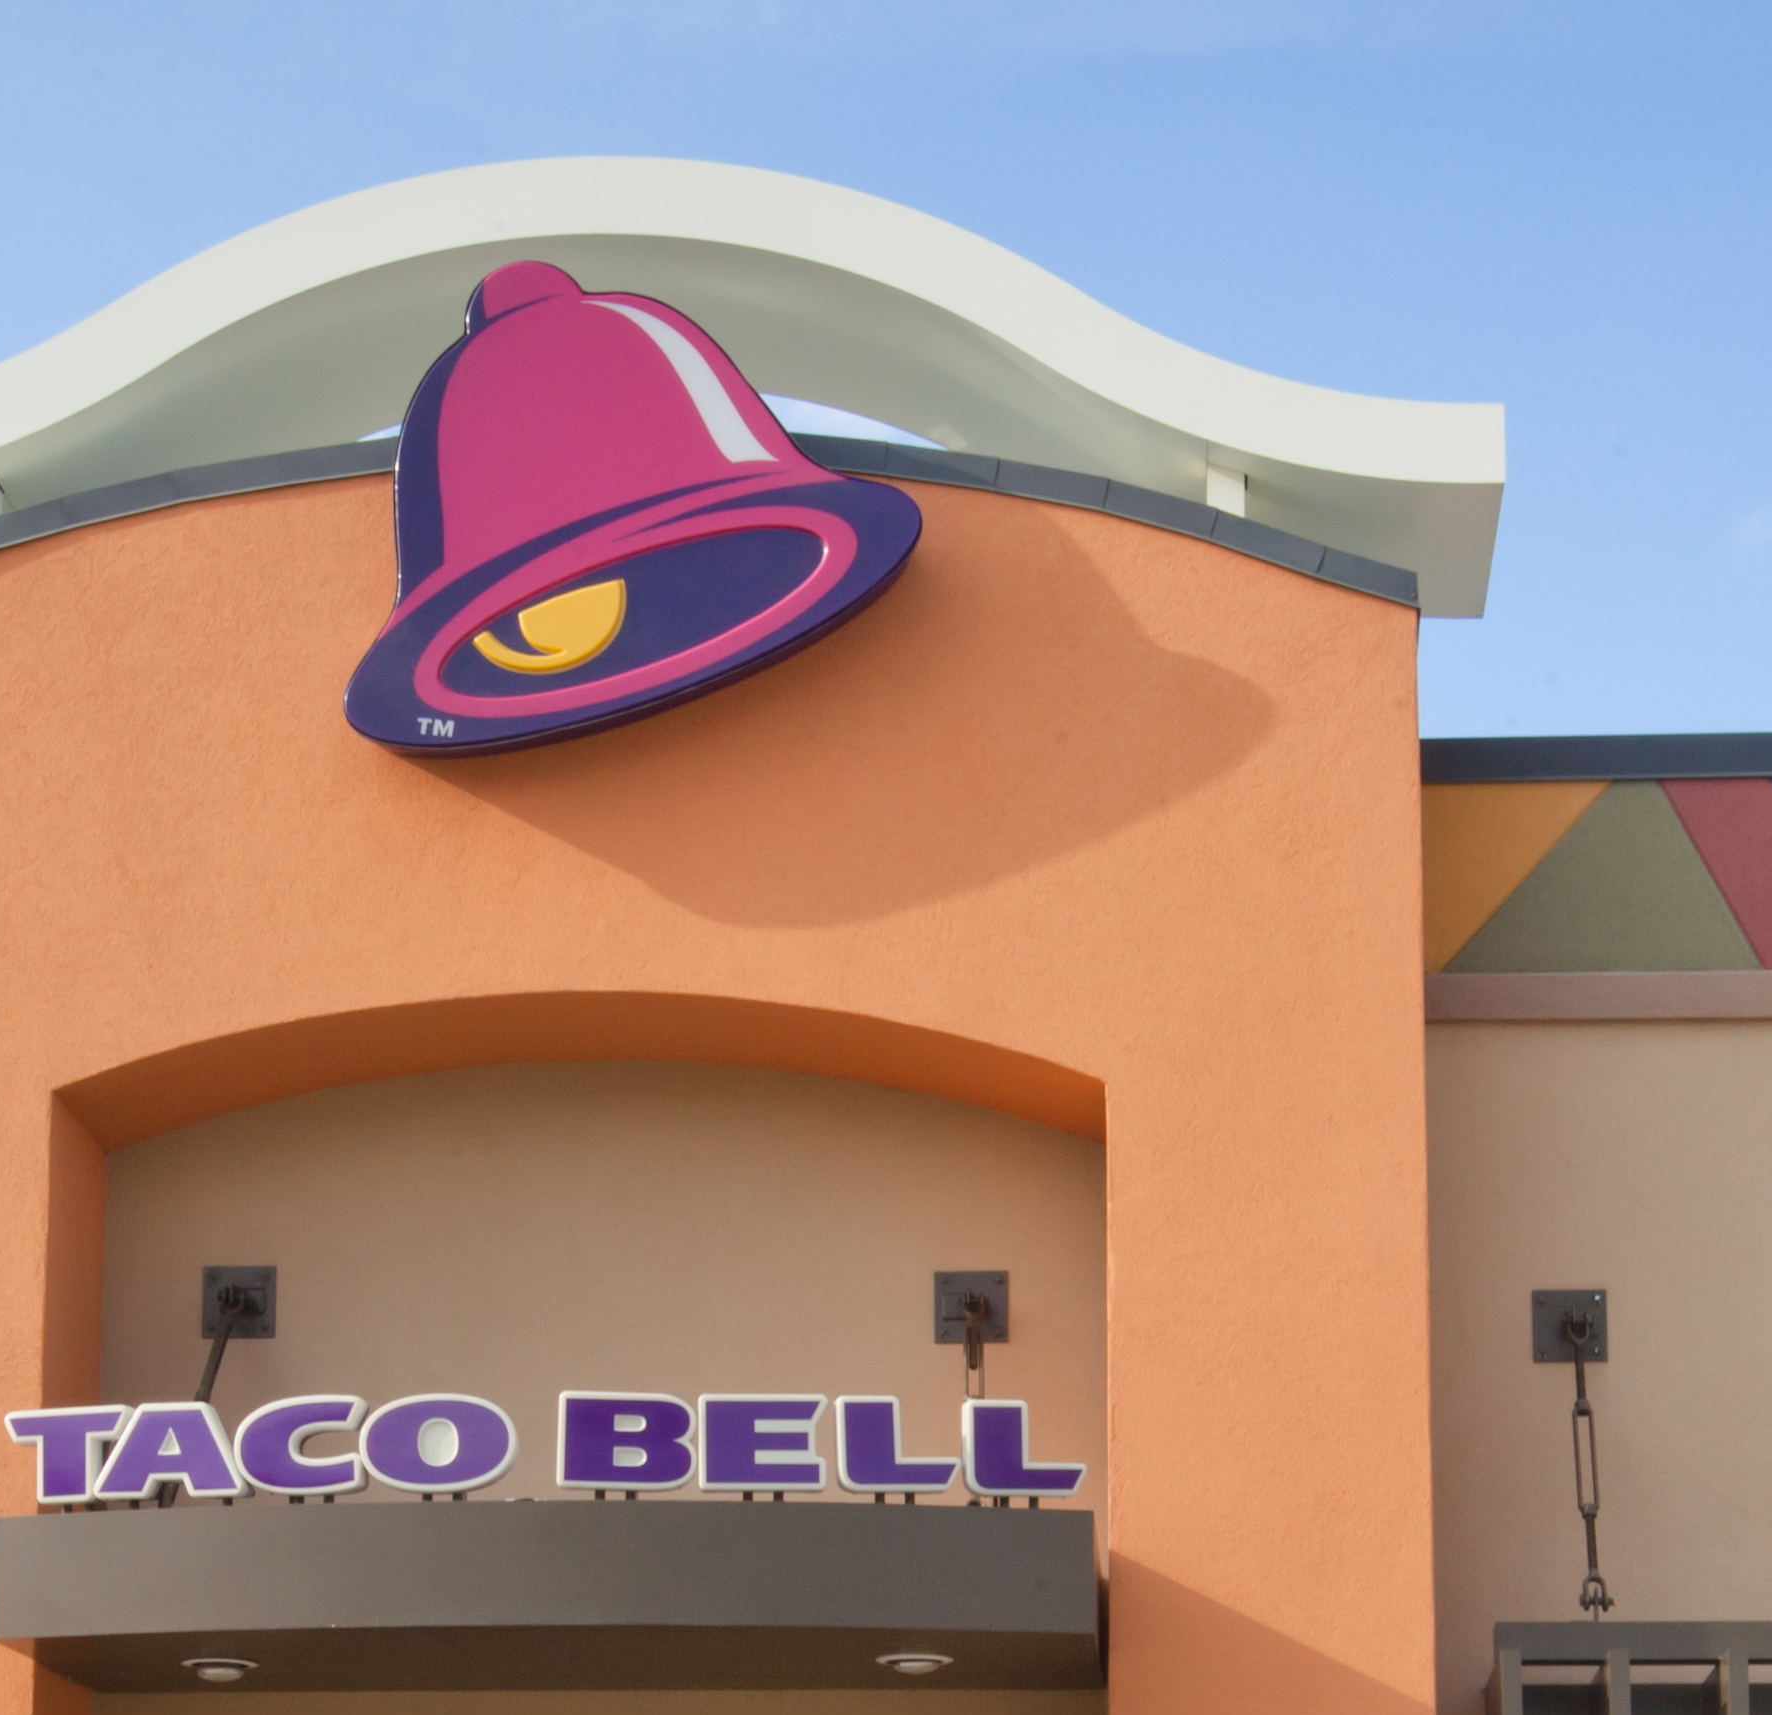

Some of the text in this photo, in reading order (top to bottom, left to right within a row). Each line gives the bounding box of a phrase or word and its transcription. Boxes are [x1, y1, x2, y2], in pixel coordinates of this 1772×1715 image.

[416, 717, 456, 739] TM
[4, 1390, 1087, 1505] TACO BELL
